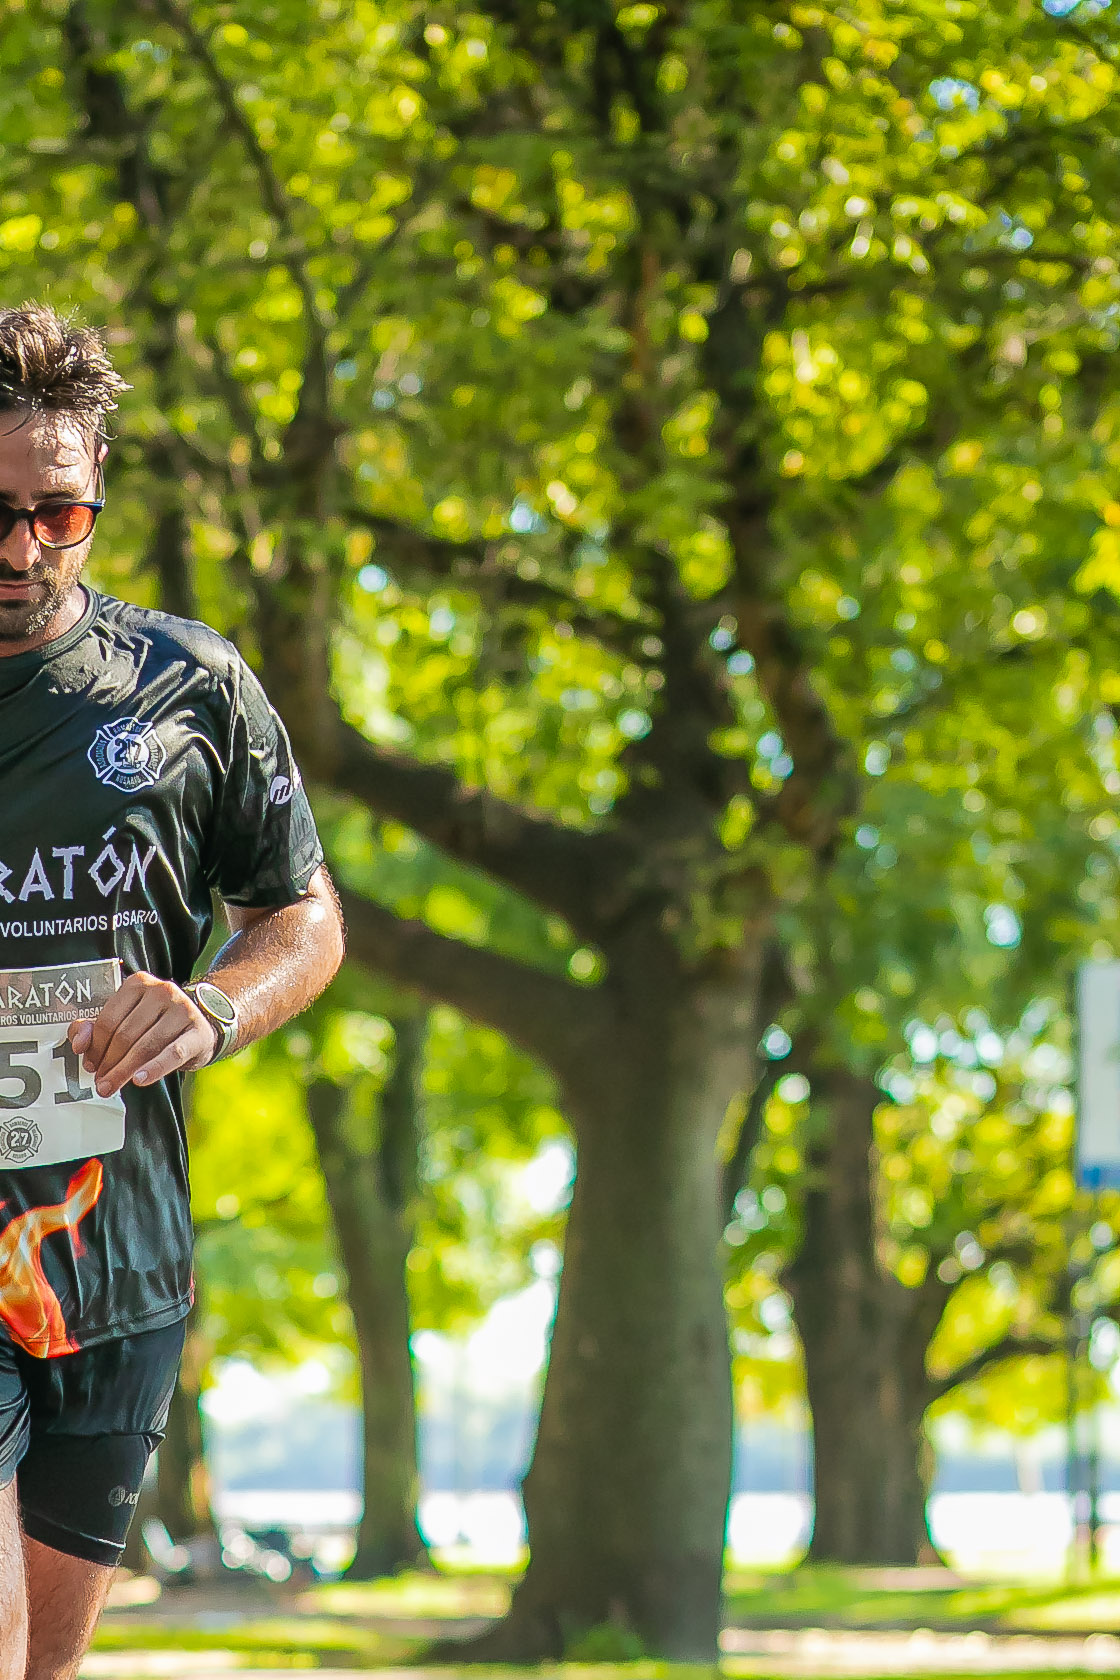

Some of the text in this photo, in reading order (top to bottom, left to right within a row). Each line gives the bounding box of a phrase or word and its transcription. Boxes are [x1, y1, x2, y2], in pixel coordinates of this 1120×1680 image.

[2, 915, 108, 938] VOLUNTARIOS
[20, 1010, 77, 1026] VOLUNTARIOS
[78, 1006, 104, 1019] ROSA
[10, 1130, 29, 1147] 27
